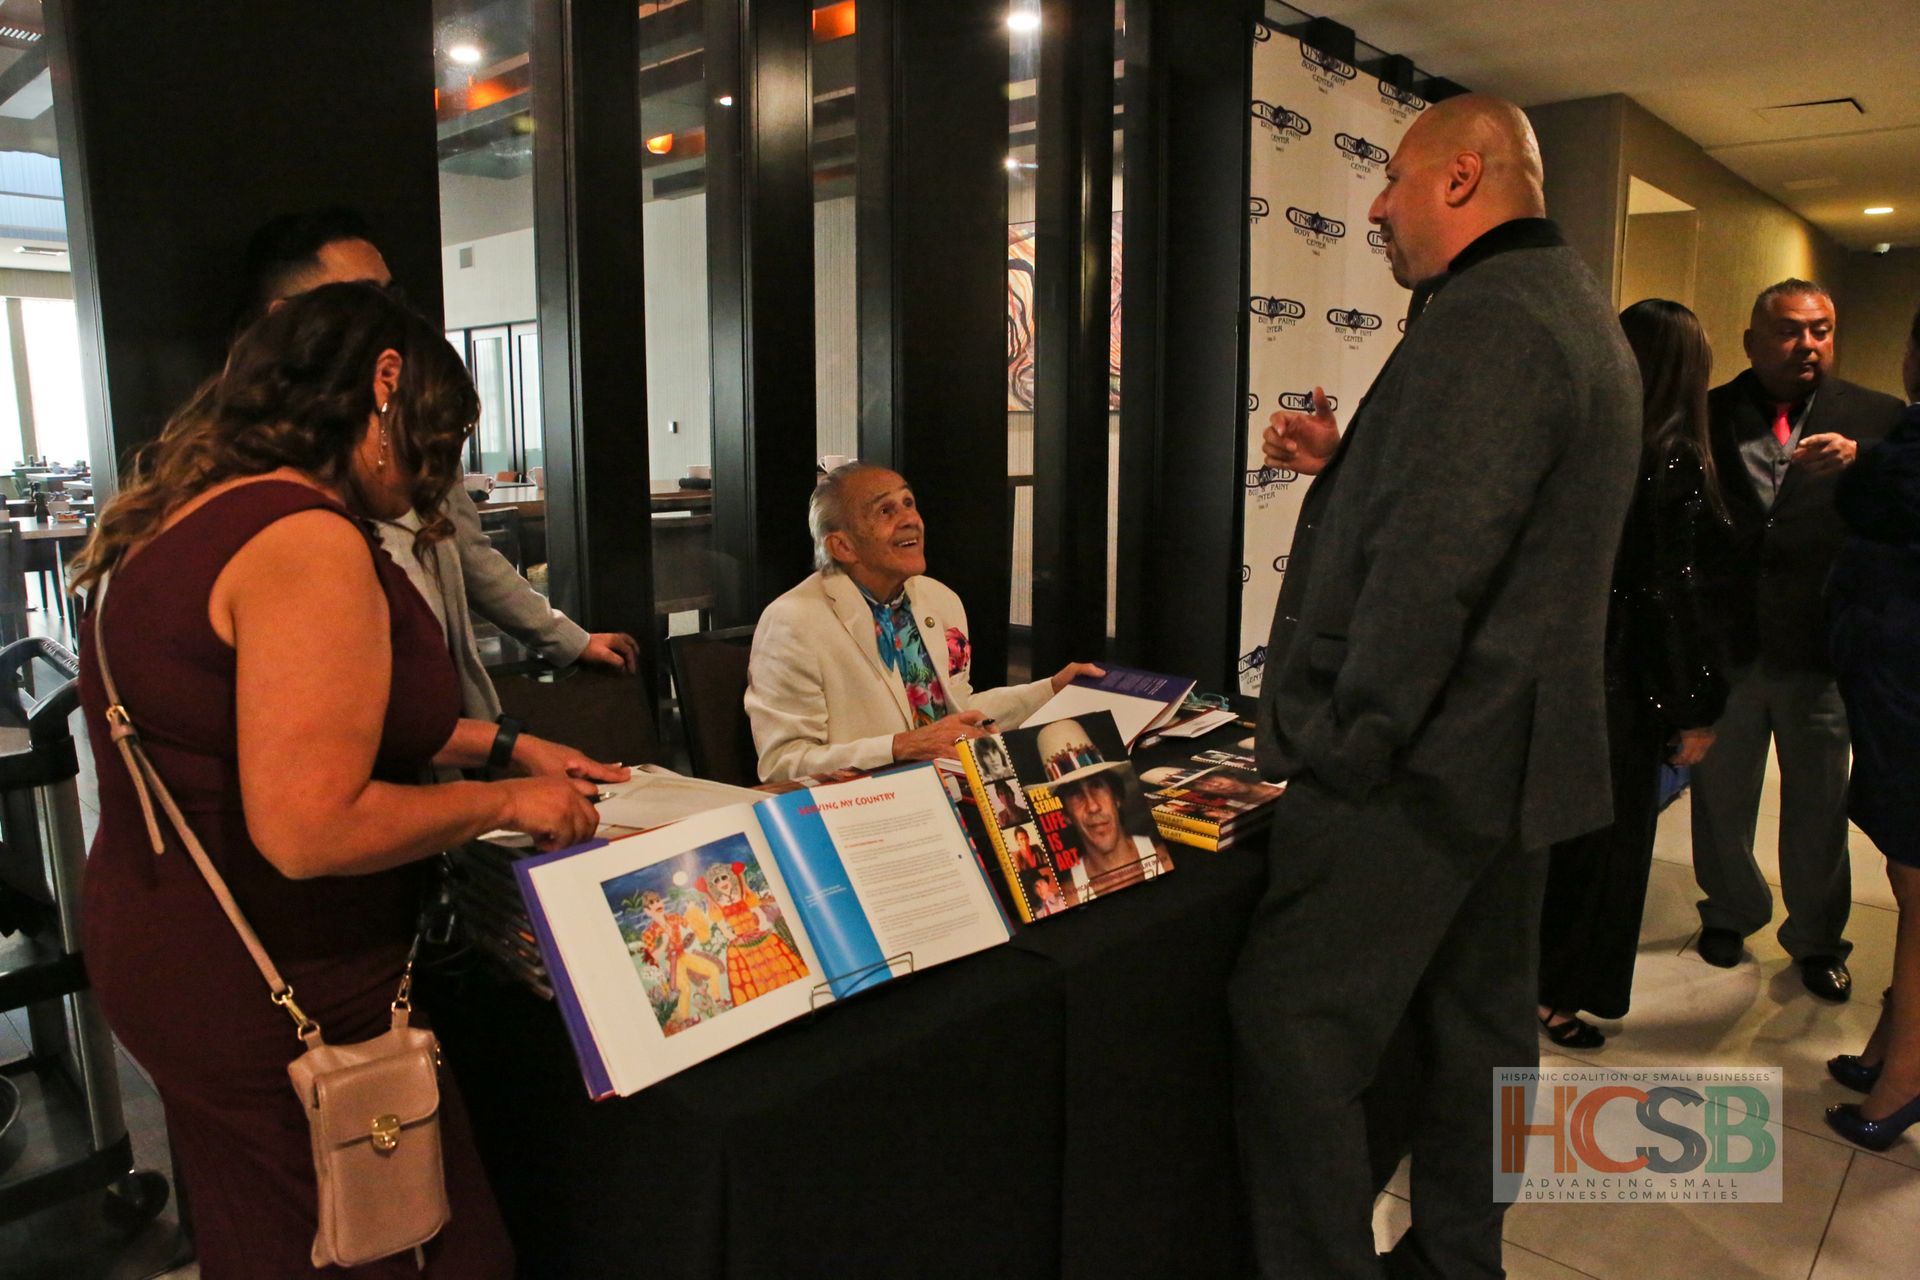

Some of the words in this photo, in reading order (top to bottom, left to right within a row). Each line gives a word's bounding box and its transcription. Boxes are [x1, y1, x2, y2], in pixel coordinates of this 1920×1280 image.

[840, 799, 853, 808] MY
[855, 792, 895, 806] COUNTRY
[1028, 786, 1052, 802] PEPE
[1033, 796, 1063, 815] SERNA
[1039, 811, 1067, 833] LIFE
[1047, 832, 1063, 852] IS
[1055, 848, 1080, 871] ART
